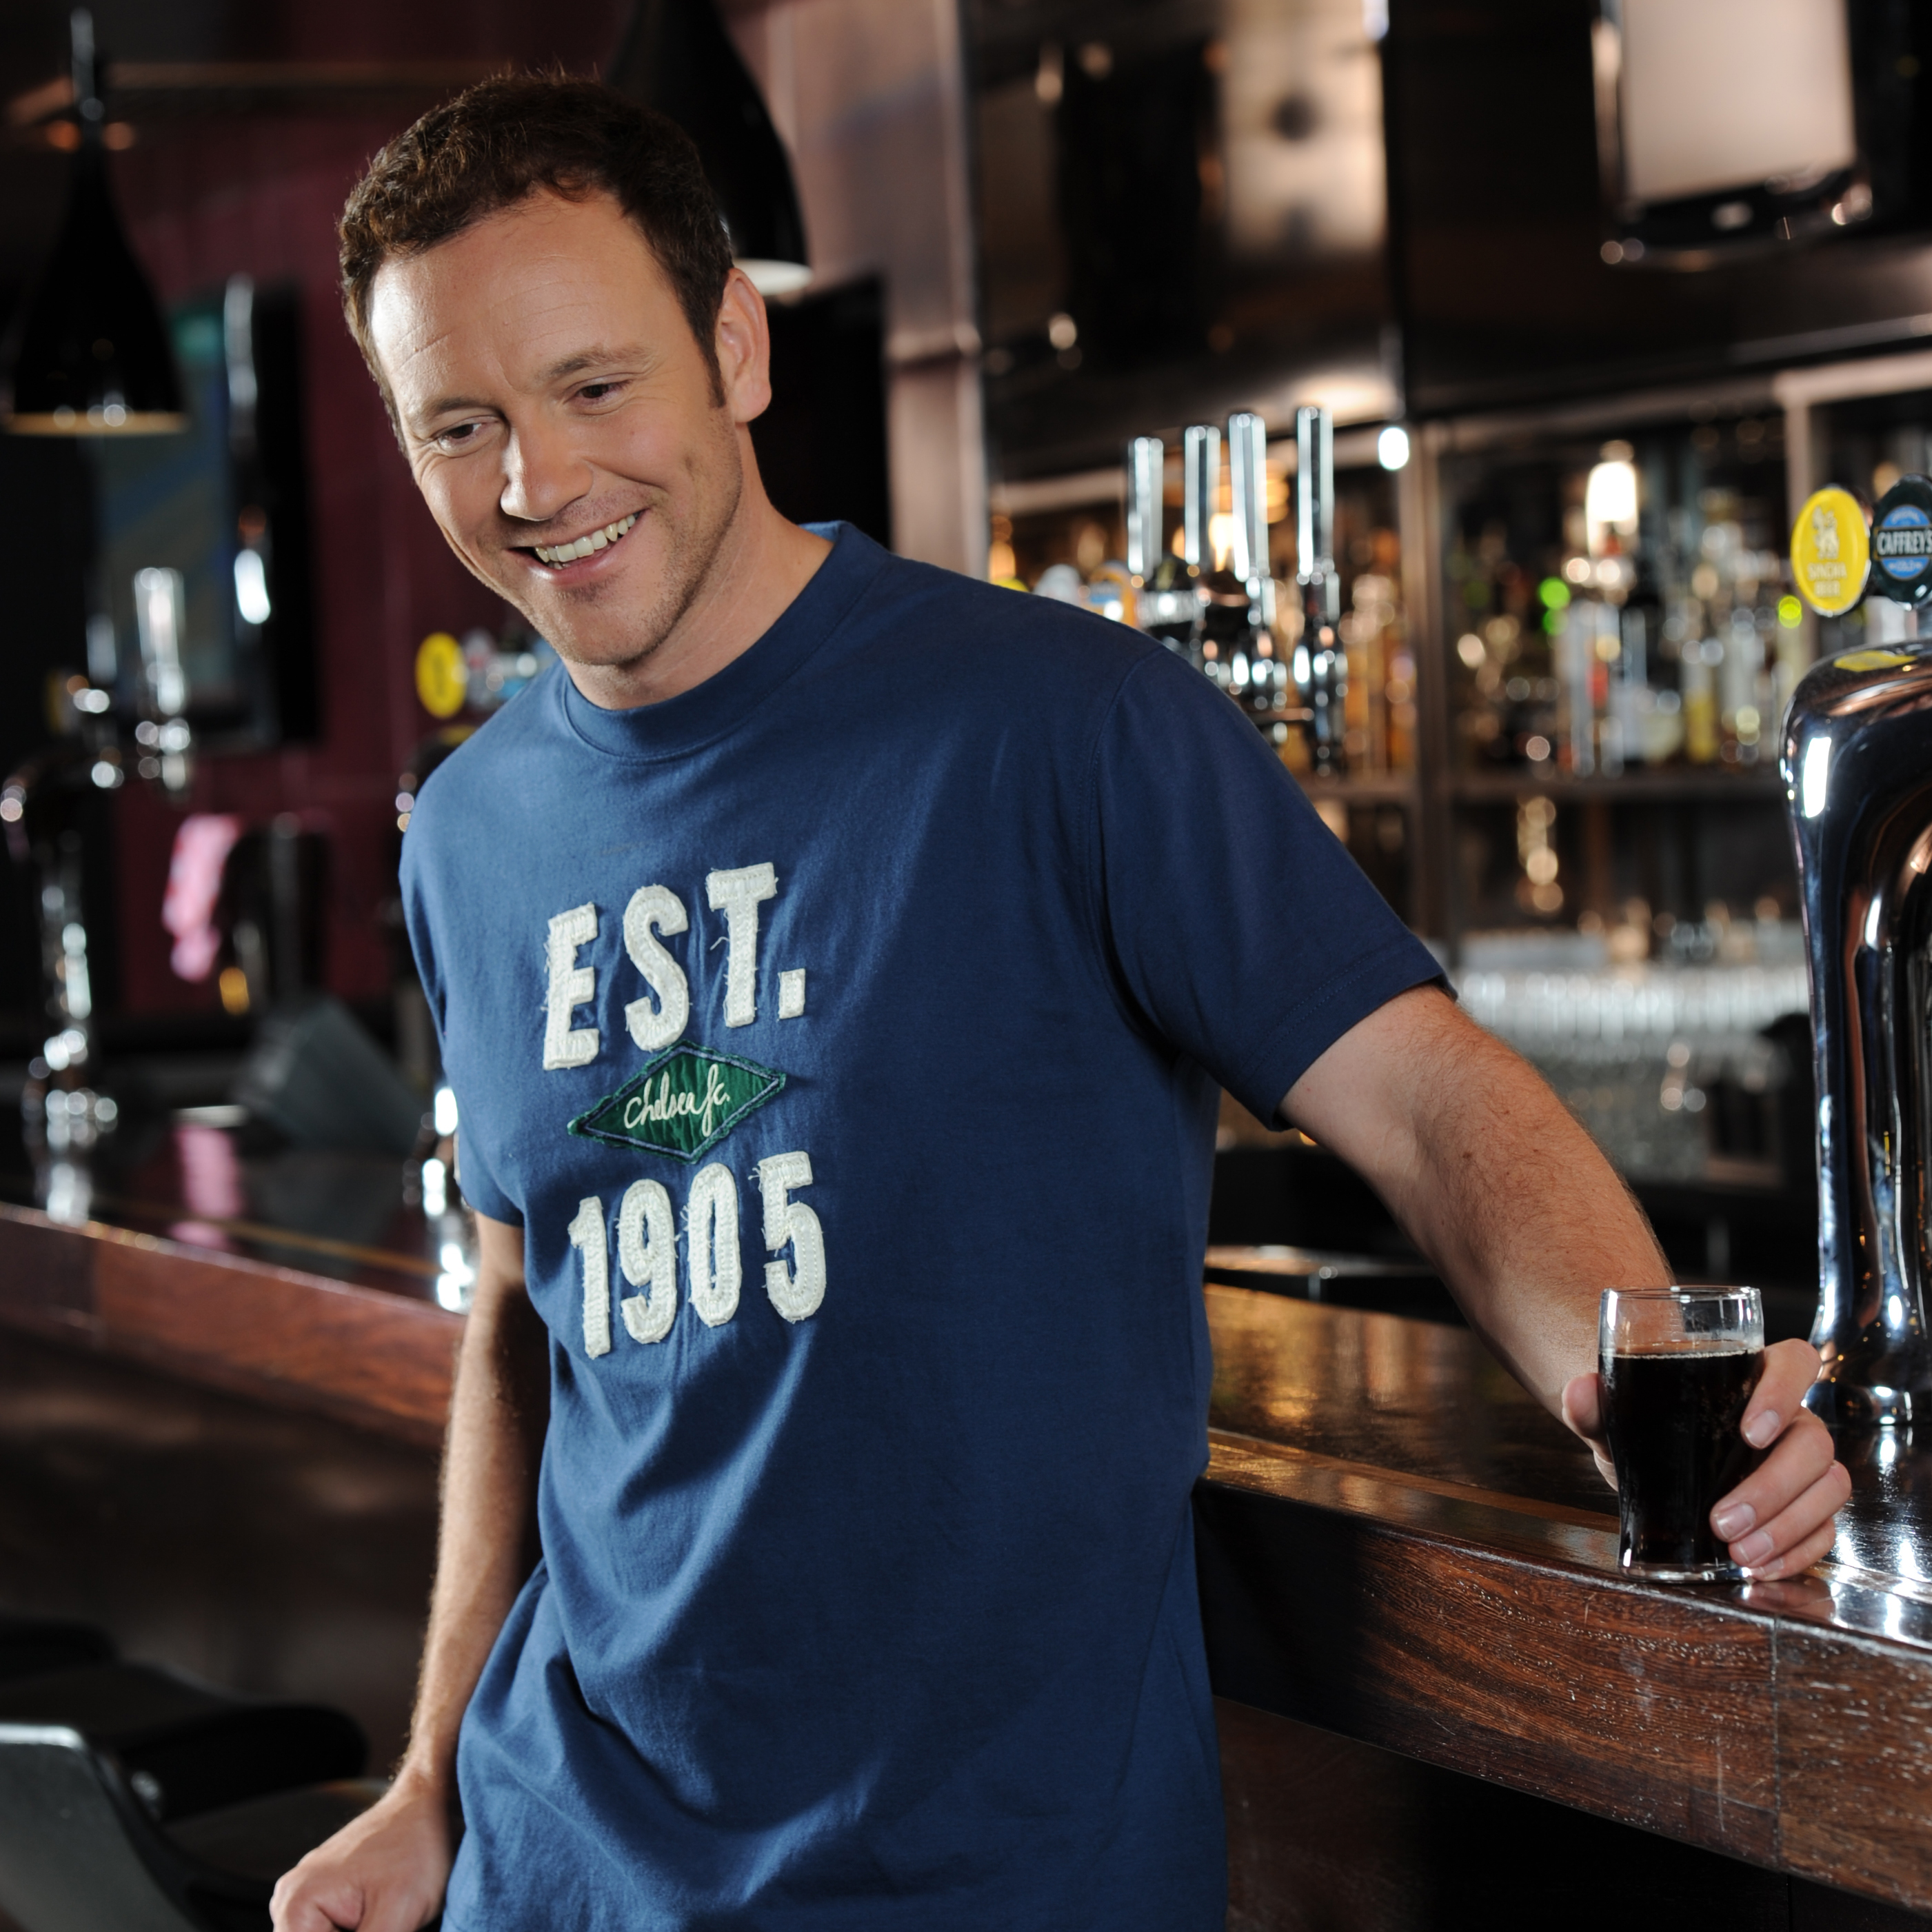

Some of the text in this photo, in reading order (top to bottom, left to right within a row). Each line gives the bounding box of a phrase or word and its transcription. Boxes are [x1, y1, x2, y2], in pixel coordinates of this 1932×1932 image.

[1807, 562, 1847, 581] SINGHA
[1814, 580, 1840, 598] BEER
[543, 862, 805, 1070] EST.
[568, 1151, 826, 1359] 1905
